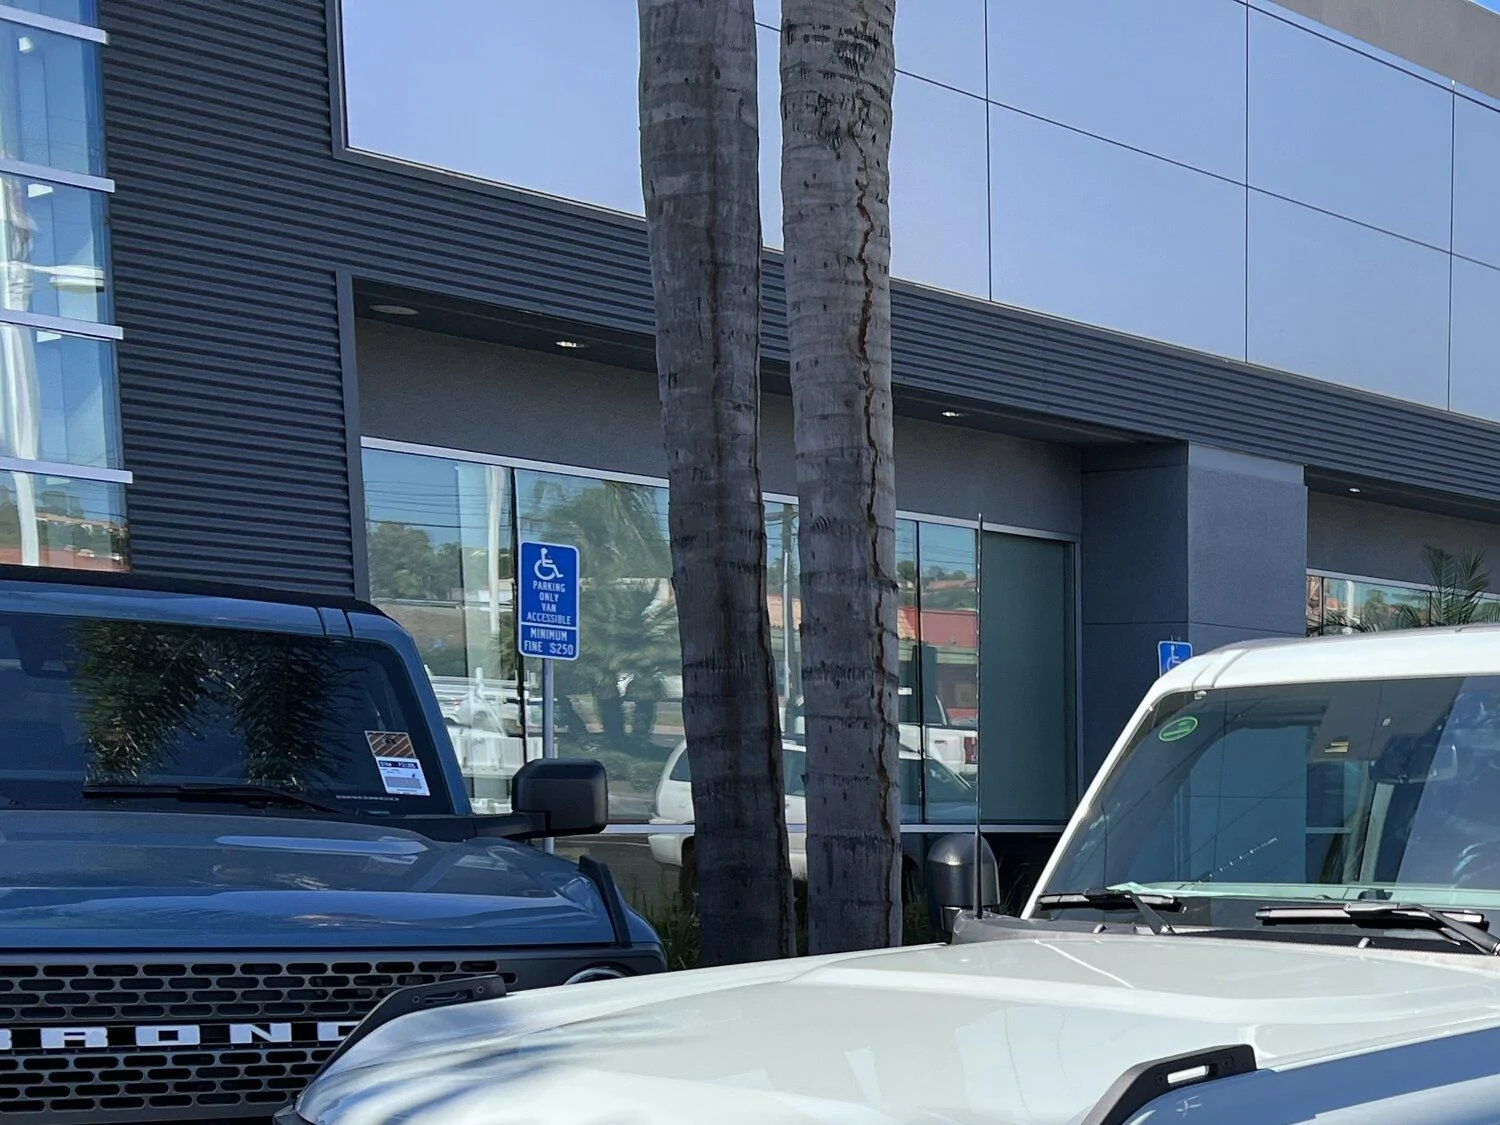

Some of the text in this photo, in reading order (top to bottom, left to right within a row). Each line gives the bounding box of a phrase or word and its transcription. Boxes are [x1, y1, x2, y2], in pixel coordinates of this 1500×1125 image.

[533, 580, 566, 593] PARKING
[539, 592, 559, 602] ONLY
[541, 602, 557, 612] VAN
[527, 612, 572, 624] ACCESSIBLE
[530, 627, 568, 641] MINIMUM
[523, 640, 574, 655] FINE $250
[0, 1021, 366, 1050] RONC
